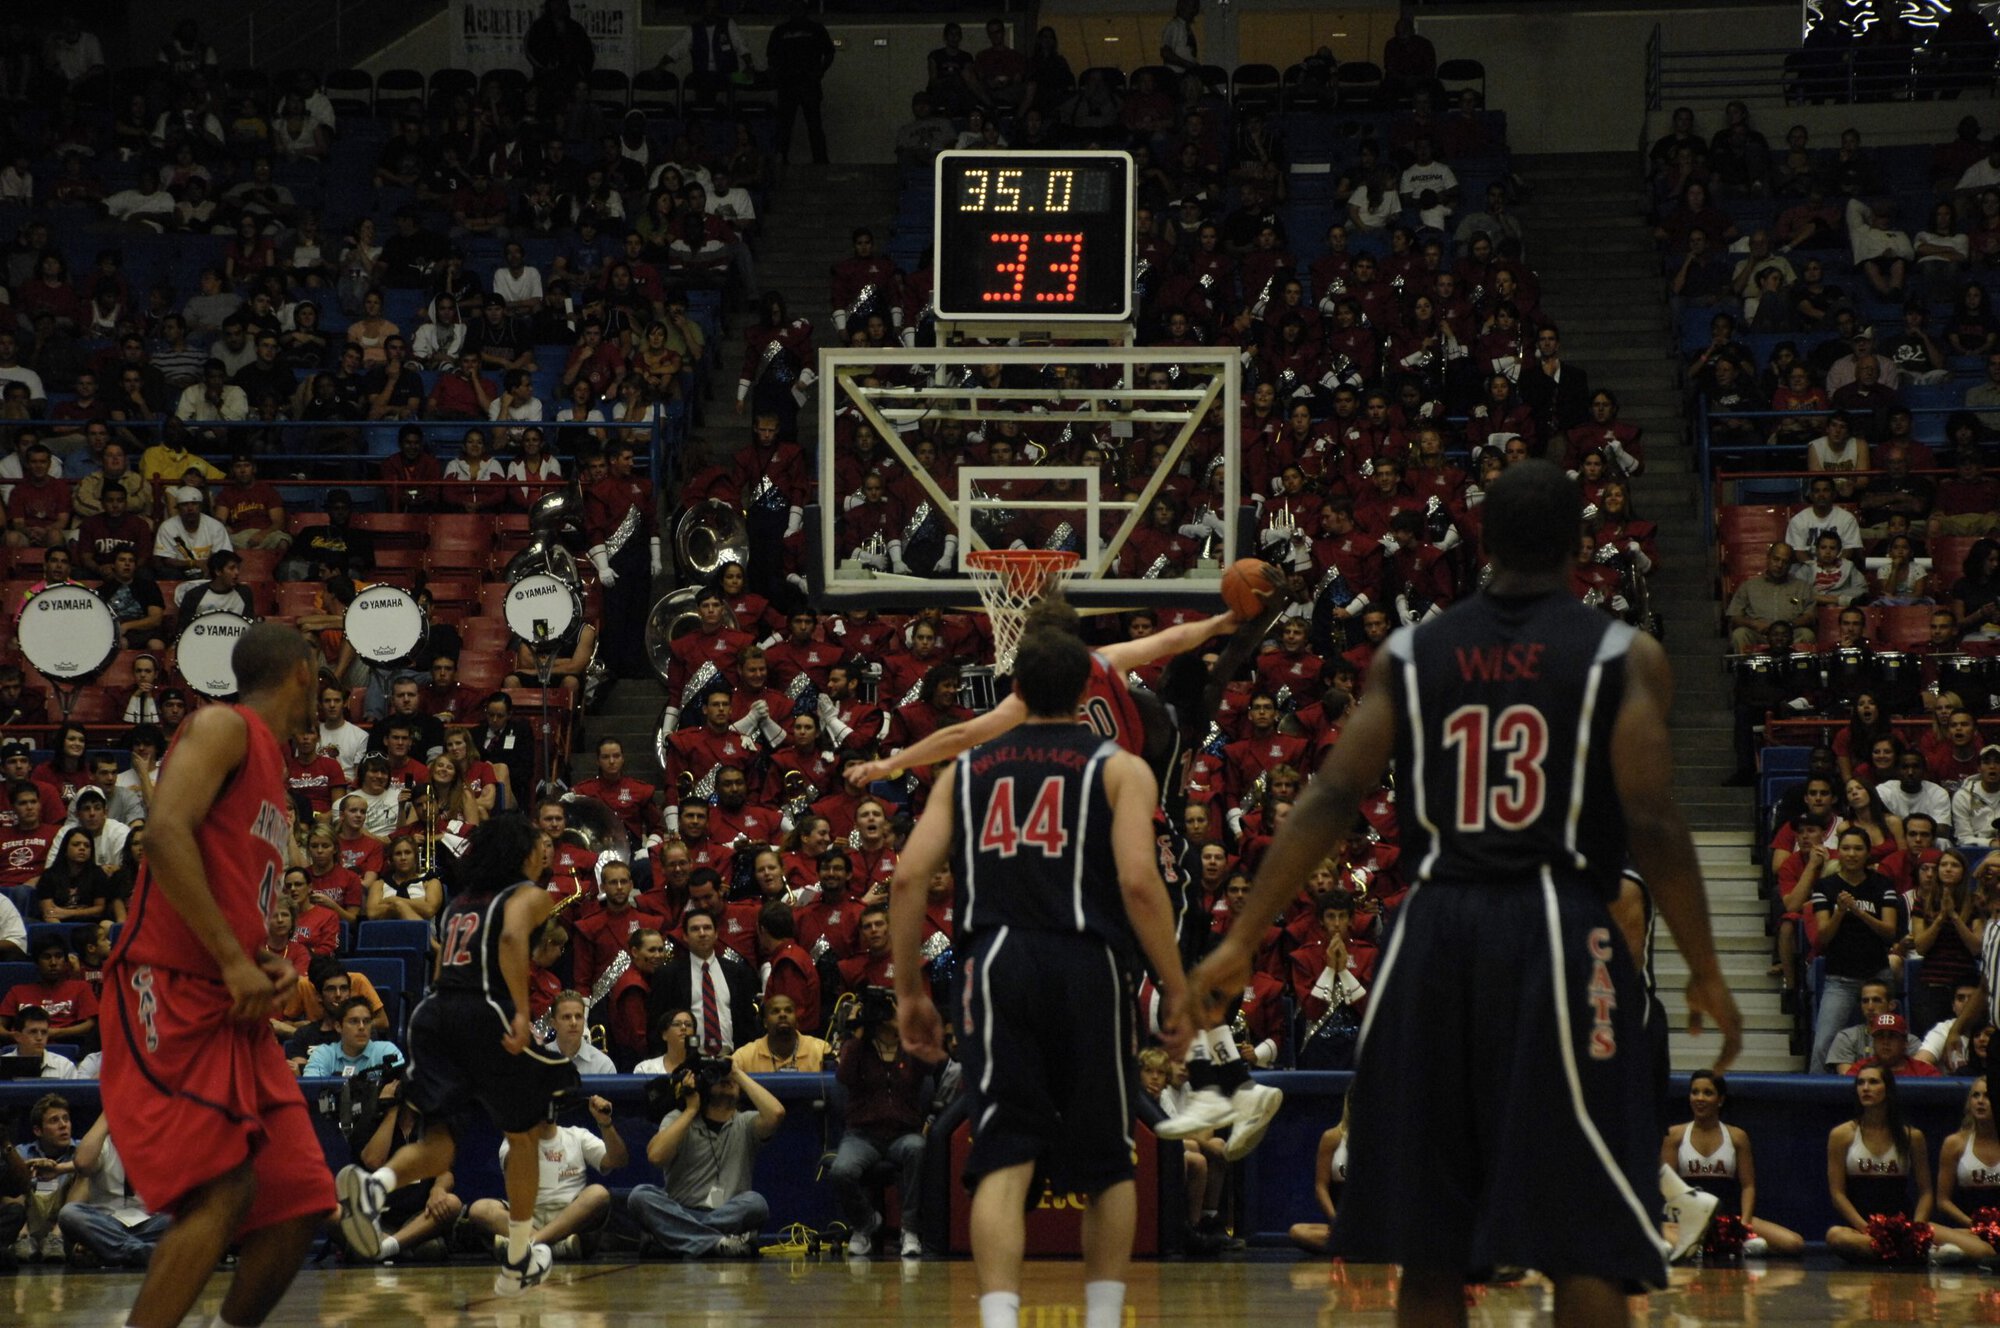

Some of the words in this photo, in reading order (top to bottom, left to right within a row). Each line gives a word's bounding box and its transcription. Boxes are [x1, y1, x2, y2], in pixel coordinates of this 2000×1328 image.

[960, 170, 1074, 212] 35.0
[982, 233, 1083, 301] 33
[51, 599, 93, 610] YAMAHA
[370, 598, 403, 609] YAMAHA
[524, 584, 558, 598] YAMAHA
[1455, 642, 1546, 683] WISE
[1442, 704, 1549, 832] 13
[979, 775, 1069, 859] 44
[24, 837, 46, 848] FARM
[1157, 834, 1178, 883] CATS
[442, 911, 480, 967] 12
[1586, 927, 1617, 1060] CATS
